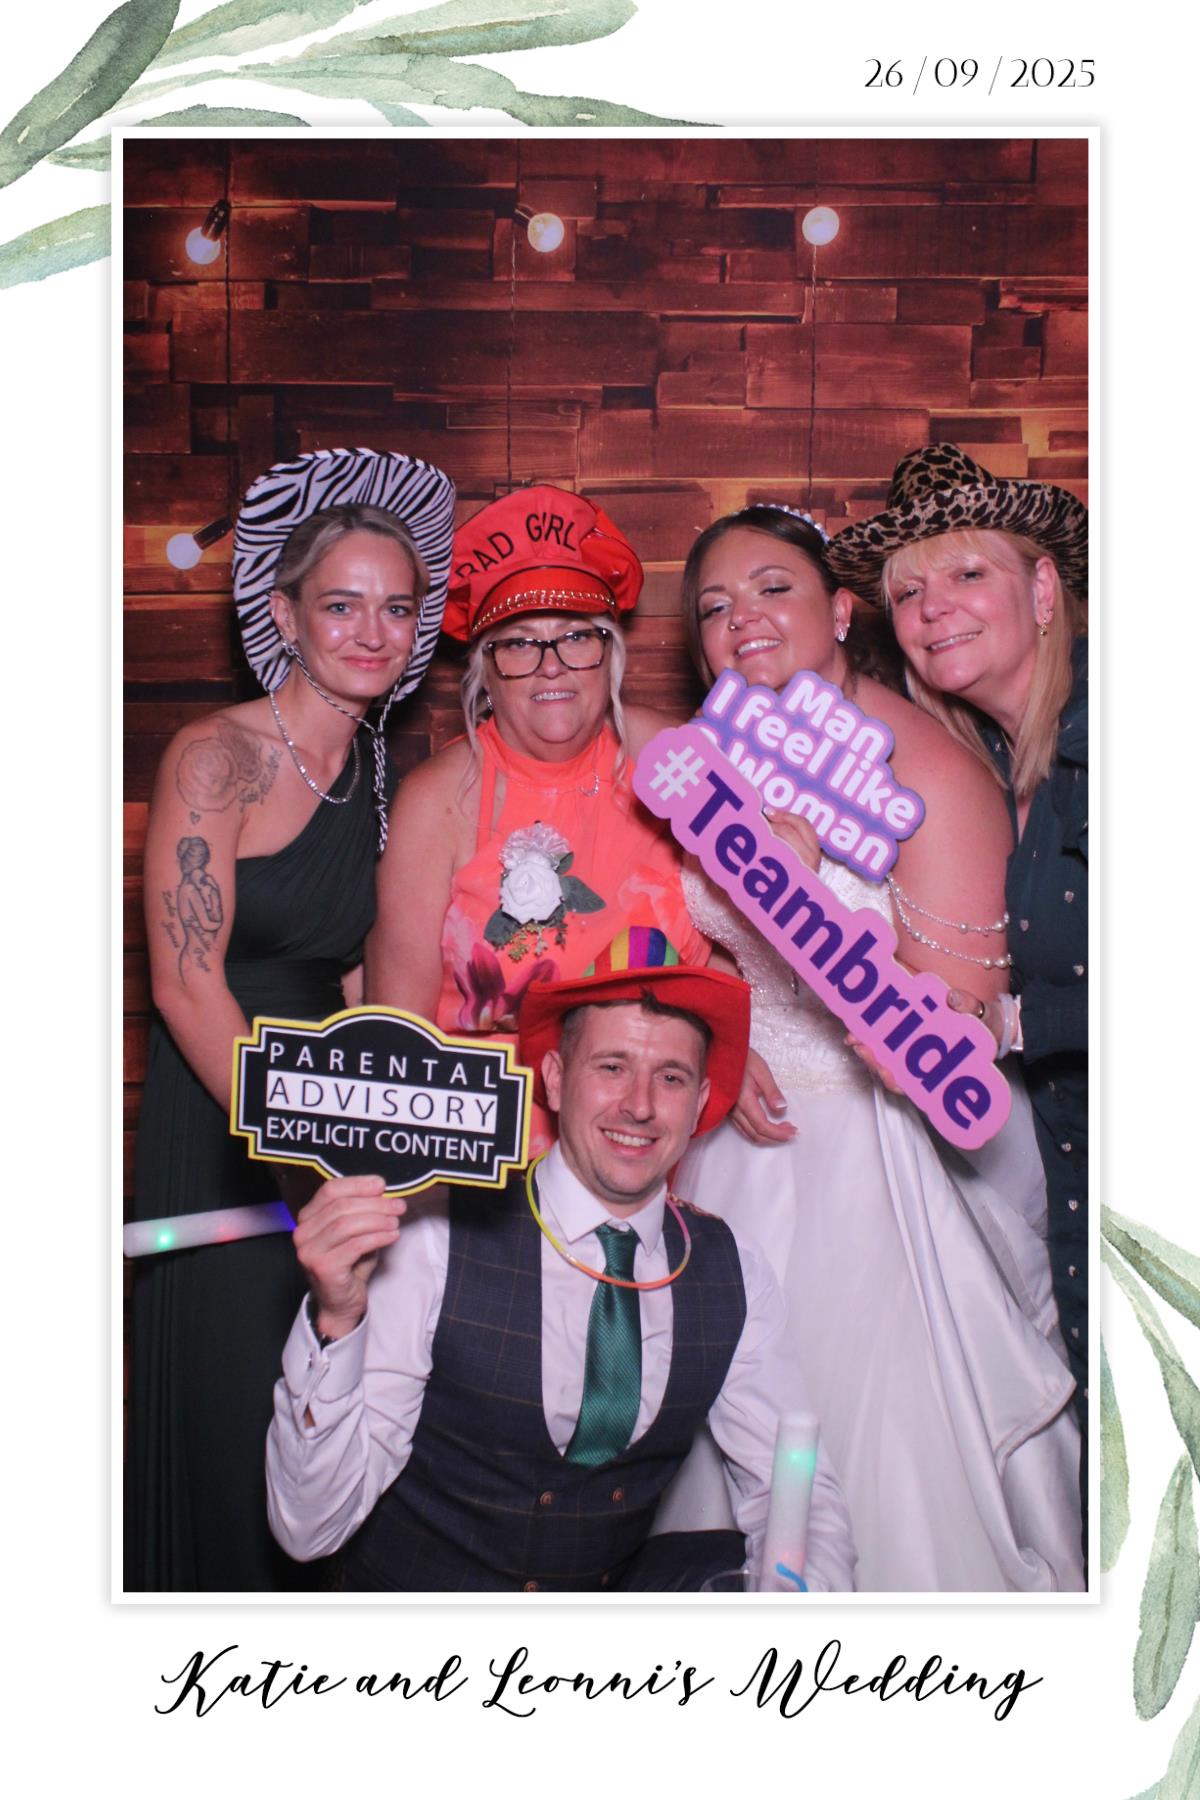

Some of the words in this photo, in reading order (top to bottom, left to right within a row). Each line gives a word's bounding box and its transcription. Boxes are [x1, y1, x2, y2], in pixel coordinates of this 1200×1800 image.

[525, 511, 578, 552] GIRL
[785, 679, 885, 763] Man
[711, 679, 738, 715] I
[735, 694, 834, 775] feel
[829, 752, 916, 830] like
[648, 745, 992, 1130] #Teambride
[269, 1041, 498, 1089] PARENTAL
[268, 1076, 496, 1128] ADVISORY
[266, 1116, 370, 1149] EXPLICIT
[374, 1129, 495, 1163] CONTENT
